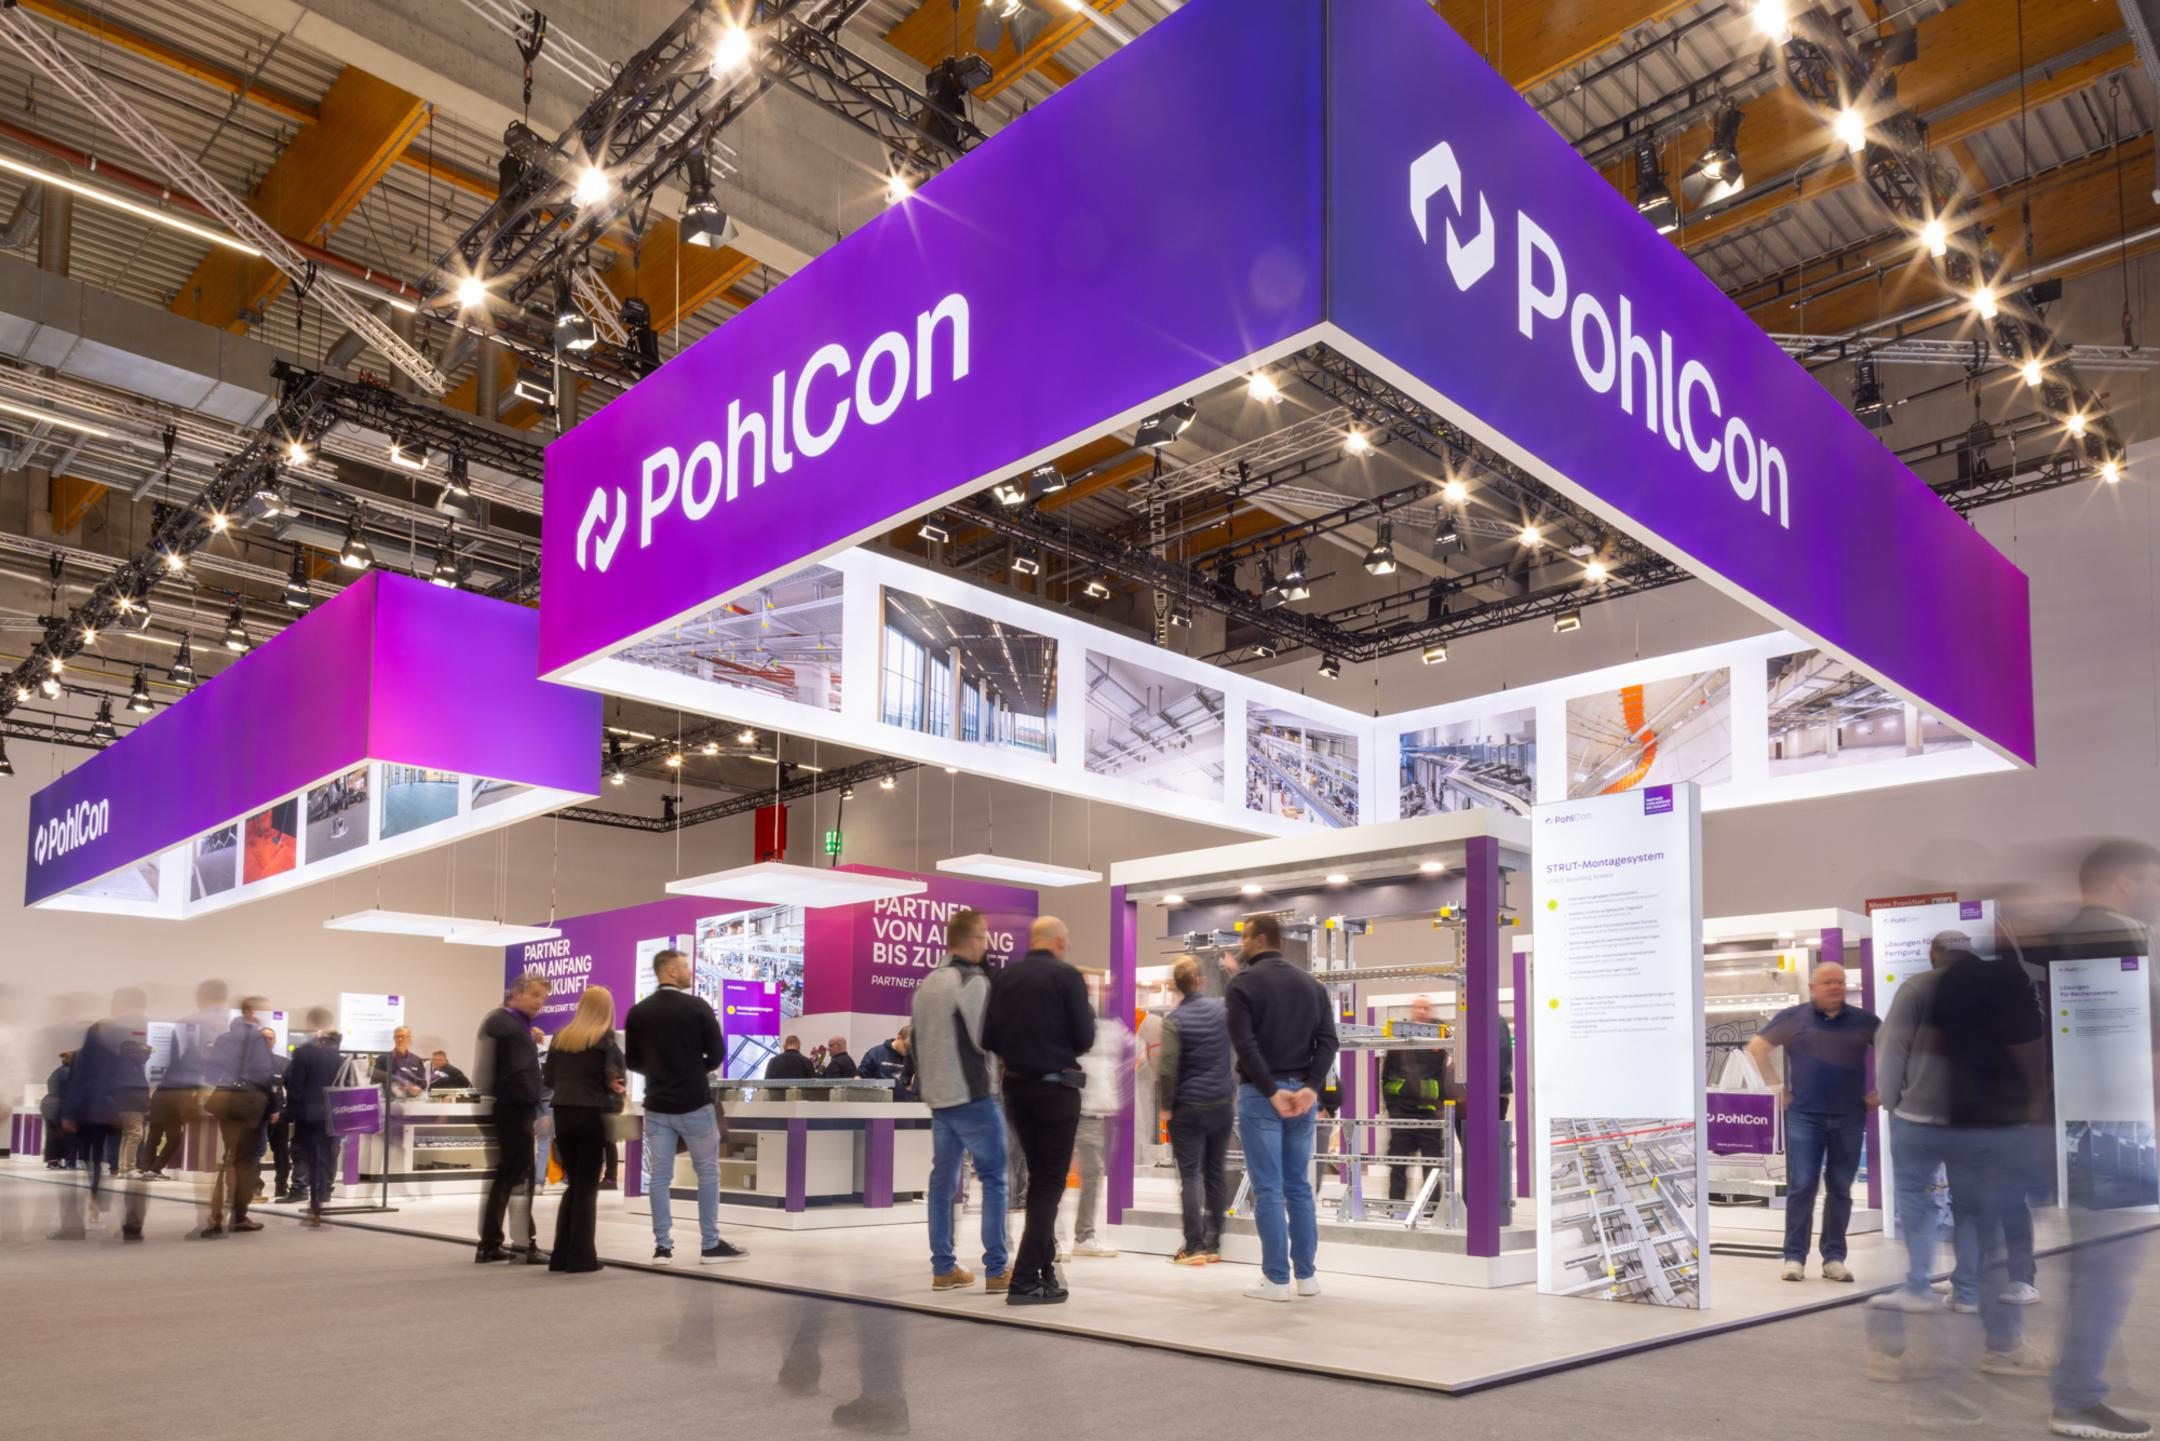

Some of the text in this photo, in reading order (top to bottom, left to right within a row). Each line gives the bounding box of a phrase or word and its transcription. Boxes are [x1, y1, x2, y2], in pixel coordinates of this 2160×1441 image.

[1518, 209, 1789, 530] PohlCon
[640, 293, 970, 548] PohlCon
[48, 798, 109, 861] PohlCon
[1554, 812, 1592, 824] PohlCon
[1546, 851, 1664, 874] STRUT-Montagesystem
[873, 917, 922, 943] VON
[524, 939, 571, 961] PARTNER
[873, 942, 908, 965] BIS
[523, 955, 592, 979] VON ANFANG
[871, 975, 915, 988] PARTNER
[1717, 1113, 1768, 1126] PohlCon
